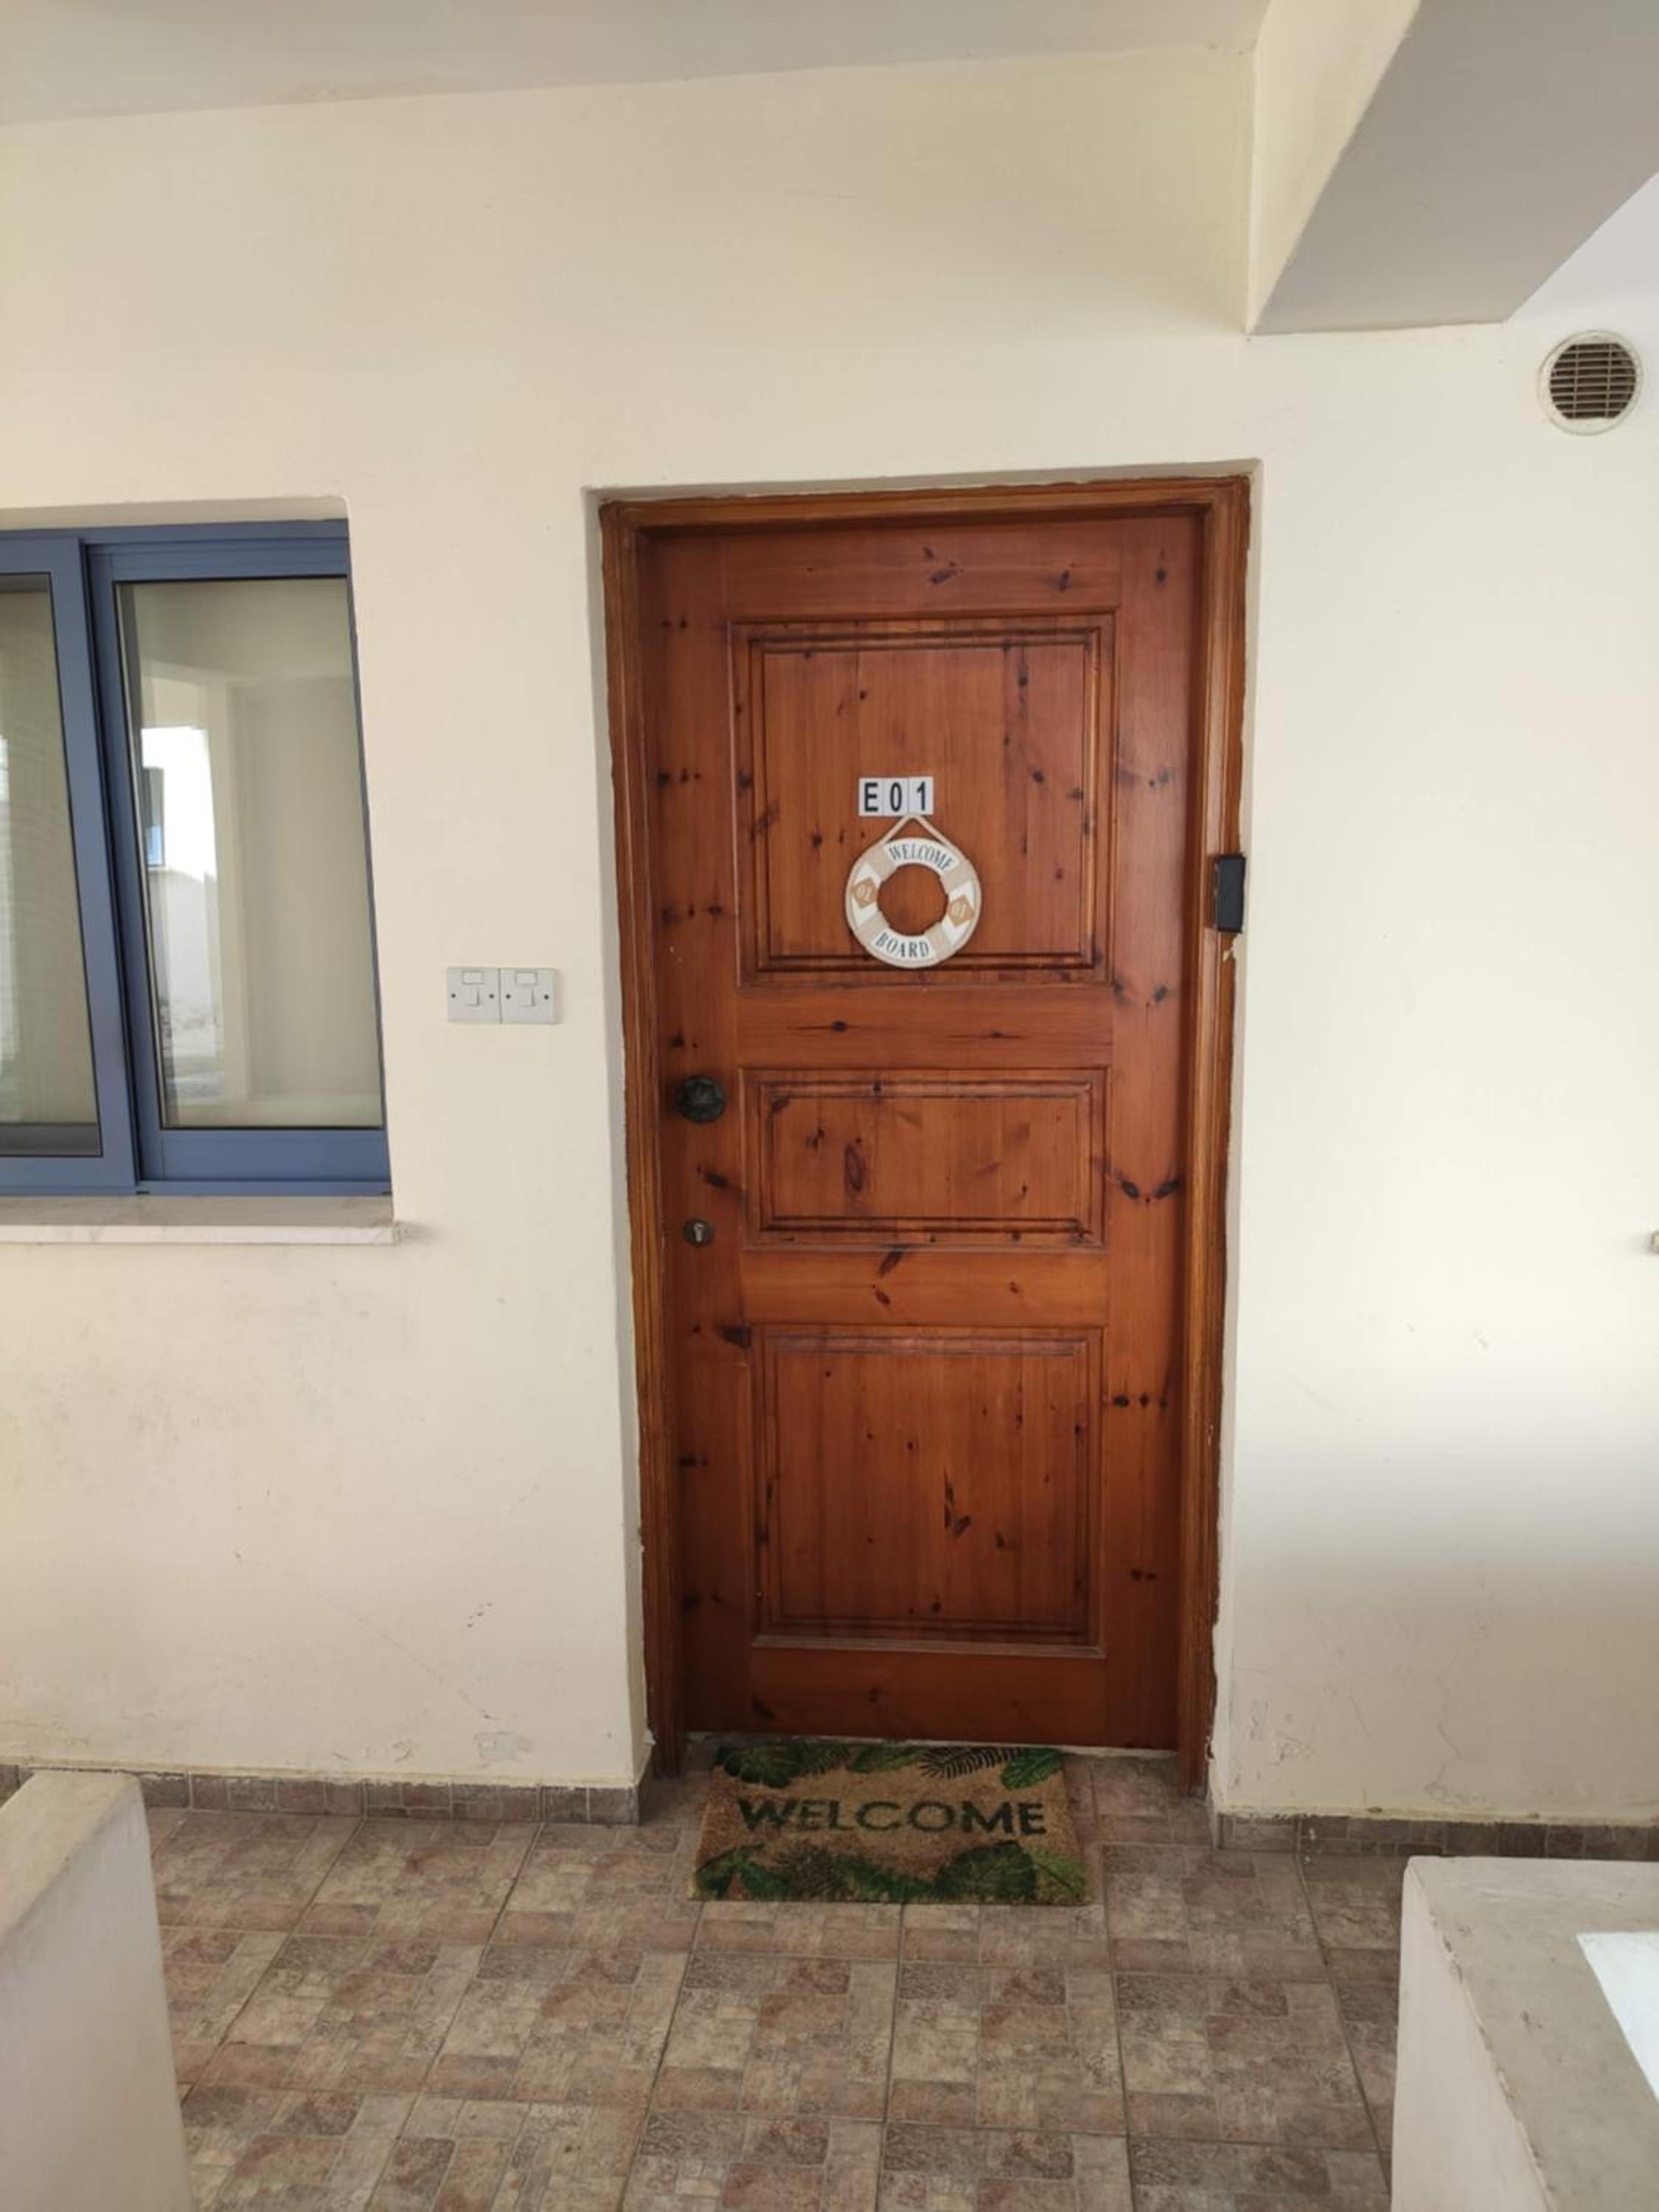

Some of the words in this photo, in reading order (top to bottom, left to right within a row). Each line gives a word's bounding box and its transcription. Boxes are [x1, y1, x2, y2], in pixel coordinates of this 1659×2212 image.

[864, 782, 926, 812] E01
[888, 844, 953, 871] WELCOME
[875, 932, 929, 958] BOARD
[738, 1798, 1046, 1834] WELCOME
